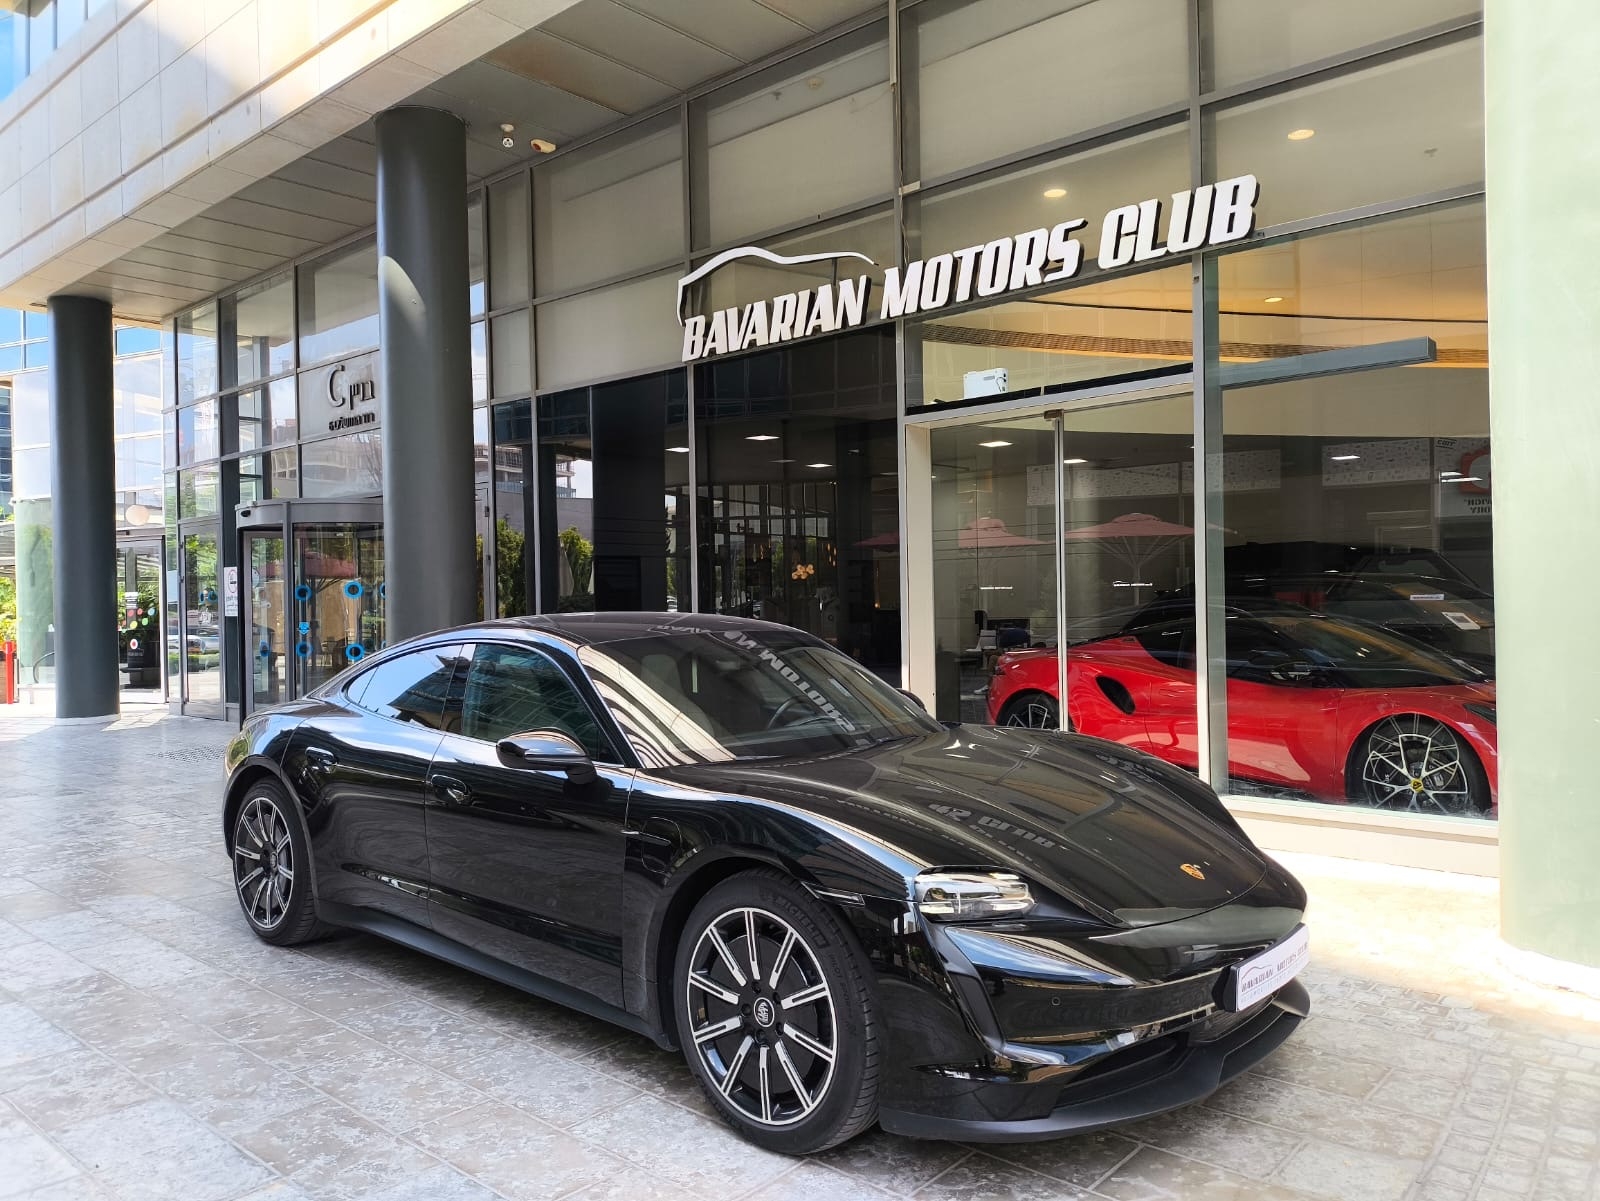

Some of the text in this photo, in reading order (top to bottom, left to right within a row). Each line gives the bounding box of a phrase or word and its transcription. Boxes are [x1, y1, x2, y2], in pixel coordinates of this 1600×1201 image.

[682, 173, 1259, 363] BAVARIAN MOTORS CLUB
[775, 895, 828, 946] MICHELIN
